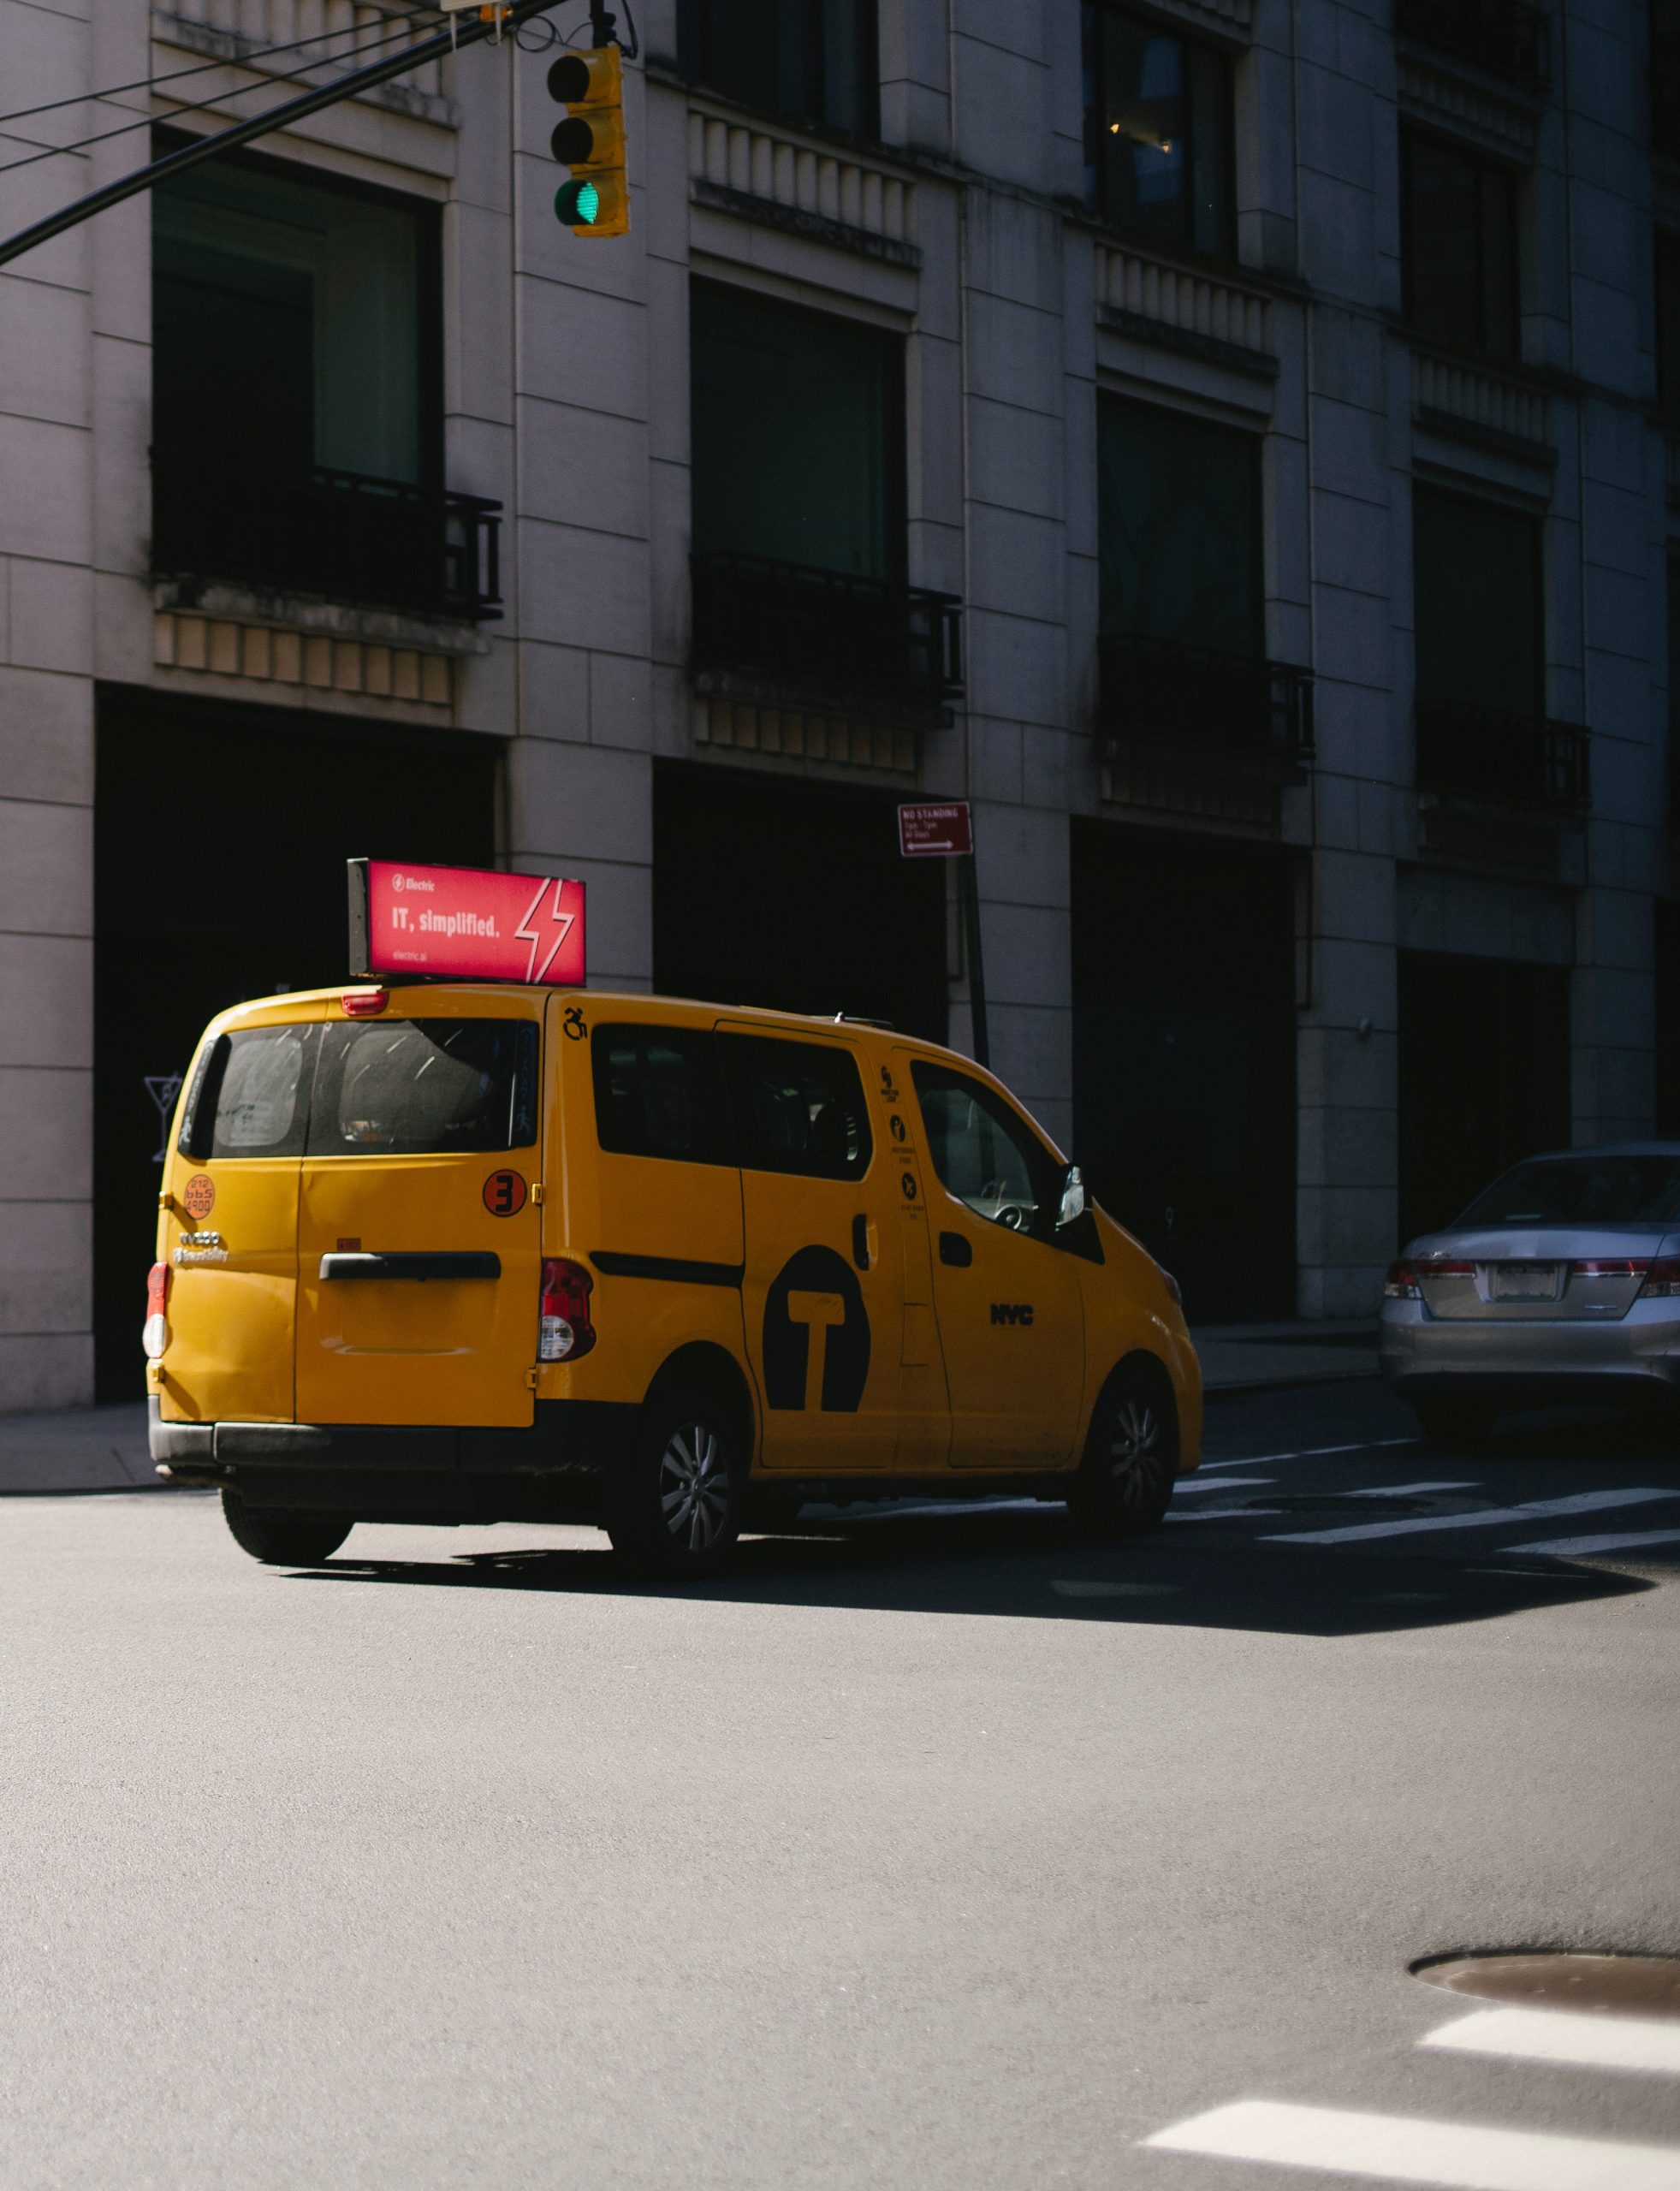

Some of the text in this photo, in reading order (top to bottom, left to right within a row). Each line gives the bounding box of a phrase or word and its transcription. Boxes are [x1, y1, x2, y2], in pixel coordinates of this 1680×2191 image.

[902, 807, 959, 820] NO STANDING
[406, 877, 435, 892] Electric
[391, 906, 501, 938] IT, simplified.
[392, 949, 427, 962] electric.ai
[191, 1179, 209, 1189] 212
[495, 1175, 513, 1212] 3
[185, 1200, 211, 1212] 4900
[990, 1303, 1034, 1326] NYC
[787, 1290, 846, 1412] T
